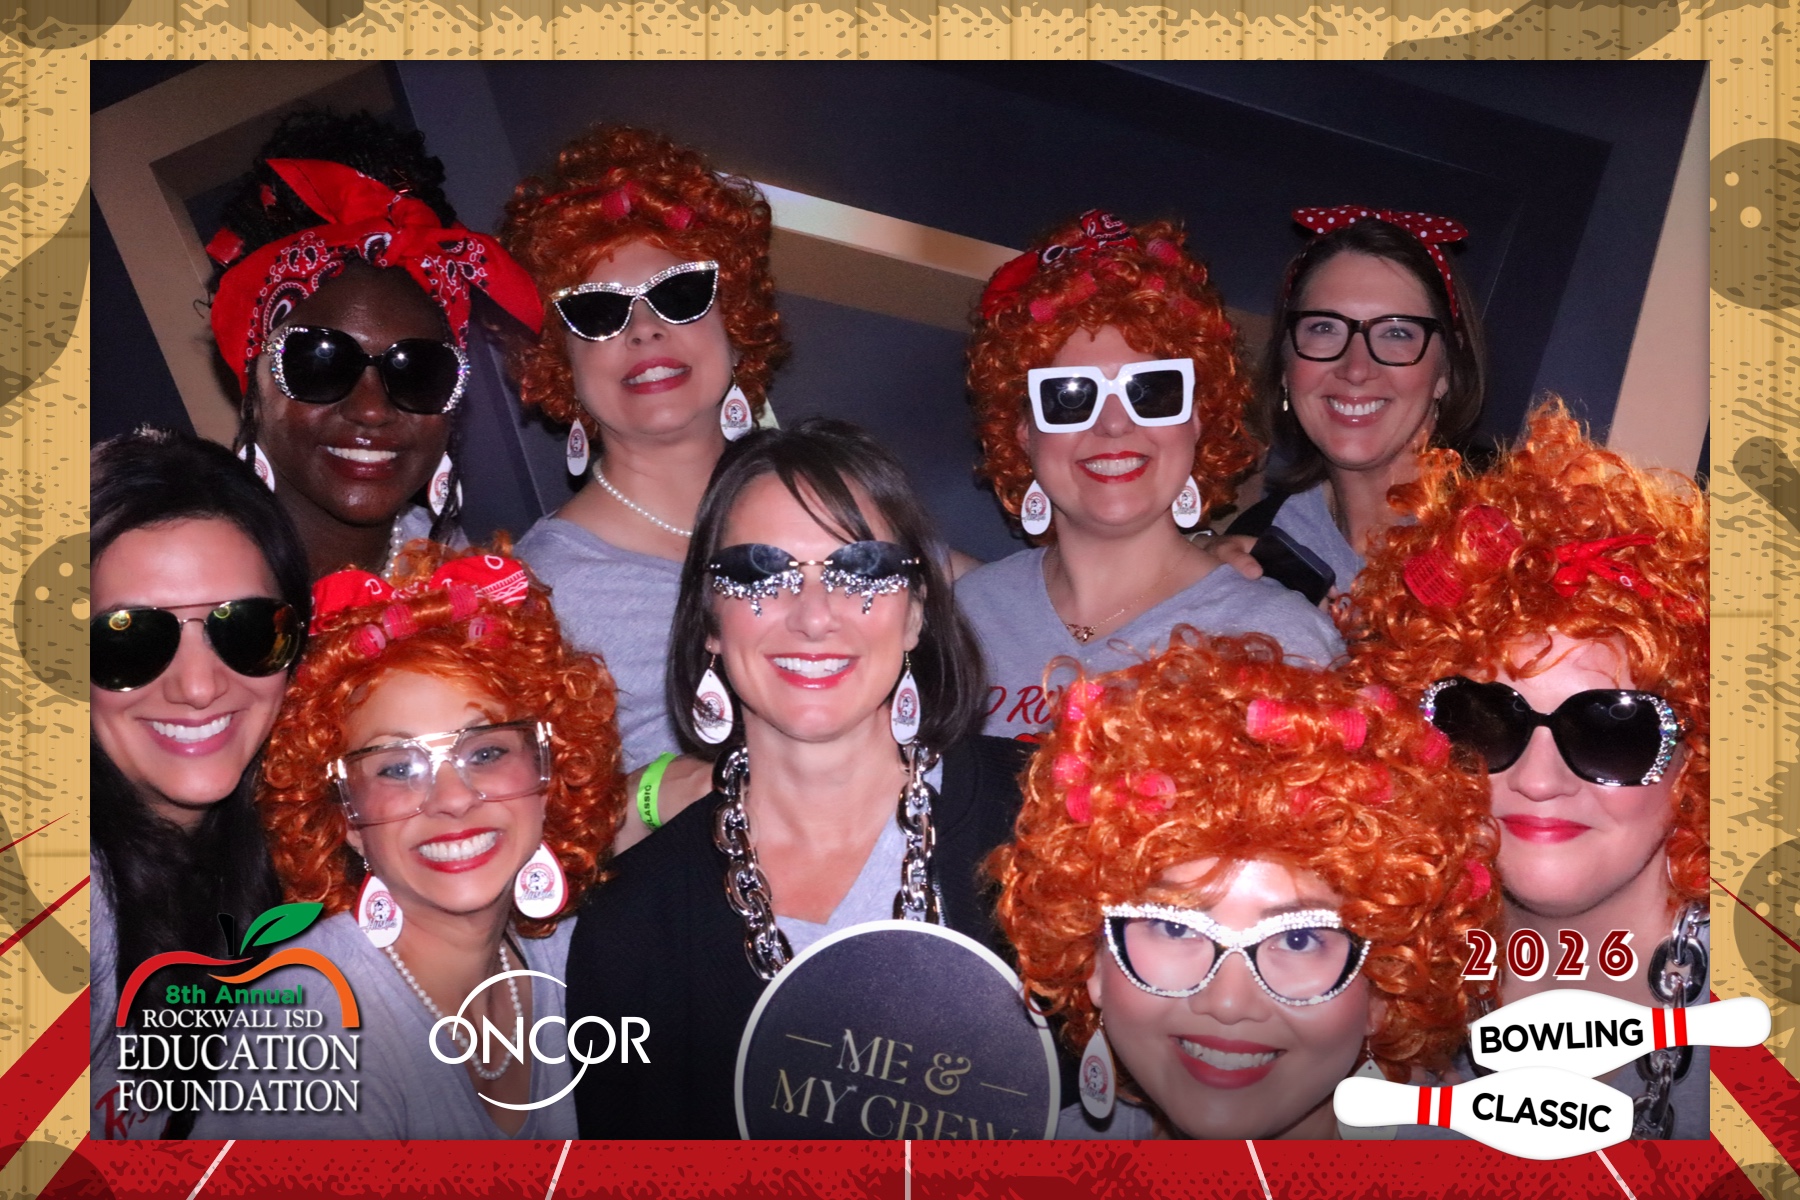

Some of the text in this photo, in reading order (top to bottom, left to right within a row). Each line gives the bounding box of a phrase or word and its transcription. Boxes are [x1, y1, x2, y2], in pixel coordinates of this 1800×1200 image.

[836, 1028, 972, 1096] ME &
[770, 1068, 859, 1124] MY
